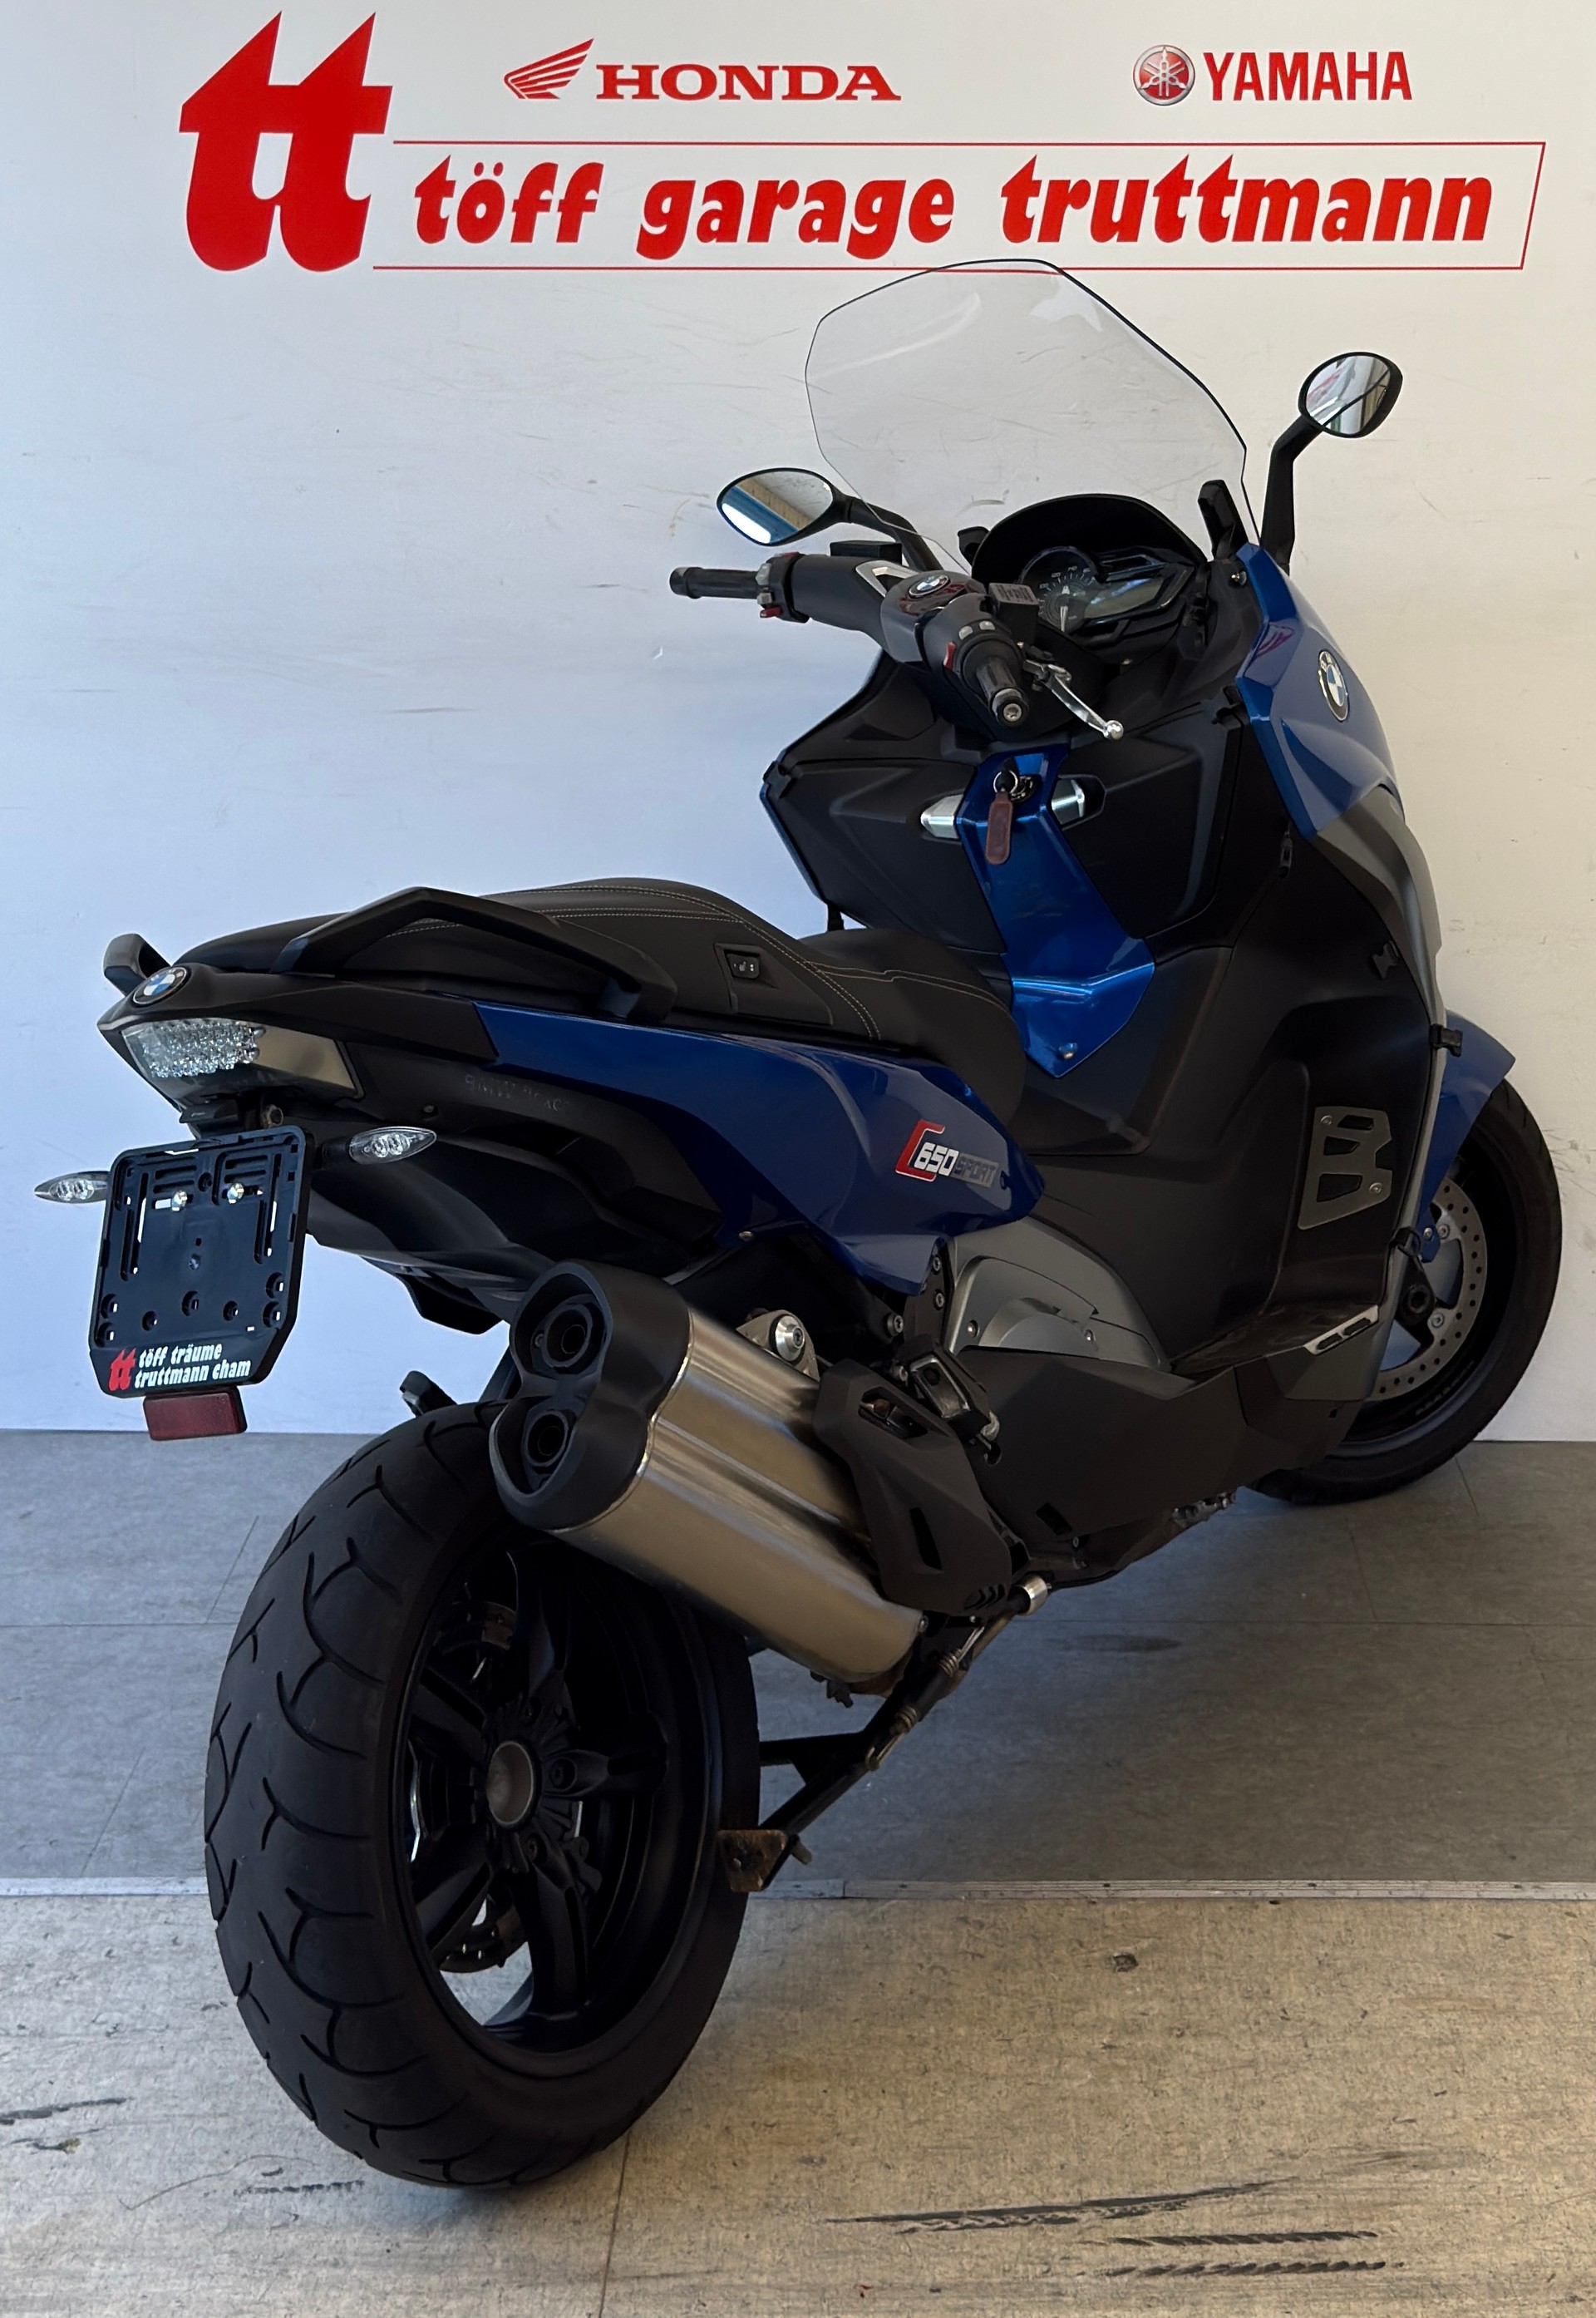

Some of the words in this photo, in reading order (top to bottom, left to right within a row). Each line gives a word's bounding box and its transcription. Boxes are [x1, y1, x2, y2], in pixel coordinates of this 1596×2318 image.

[597, 64, 901, 101] HONDA
[1203, 52, 1412, 101] YAMAHA
[414, 155, 603, 244] töff
[636, 179, 954, 260] garage
[1001, 155, 1493, 244] truttmann
[134, 1364, 209, 1388] truttmann
[212, 1359, 251, 1380] cham
[139, 1346, 168, 1368] töff
[171, 1344, 222, 1364] träume
